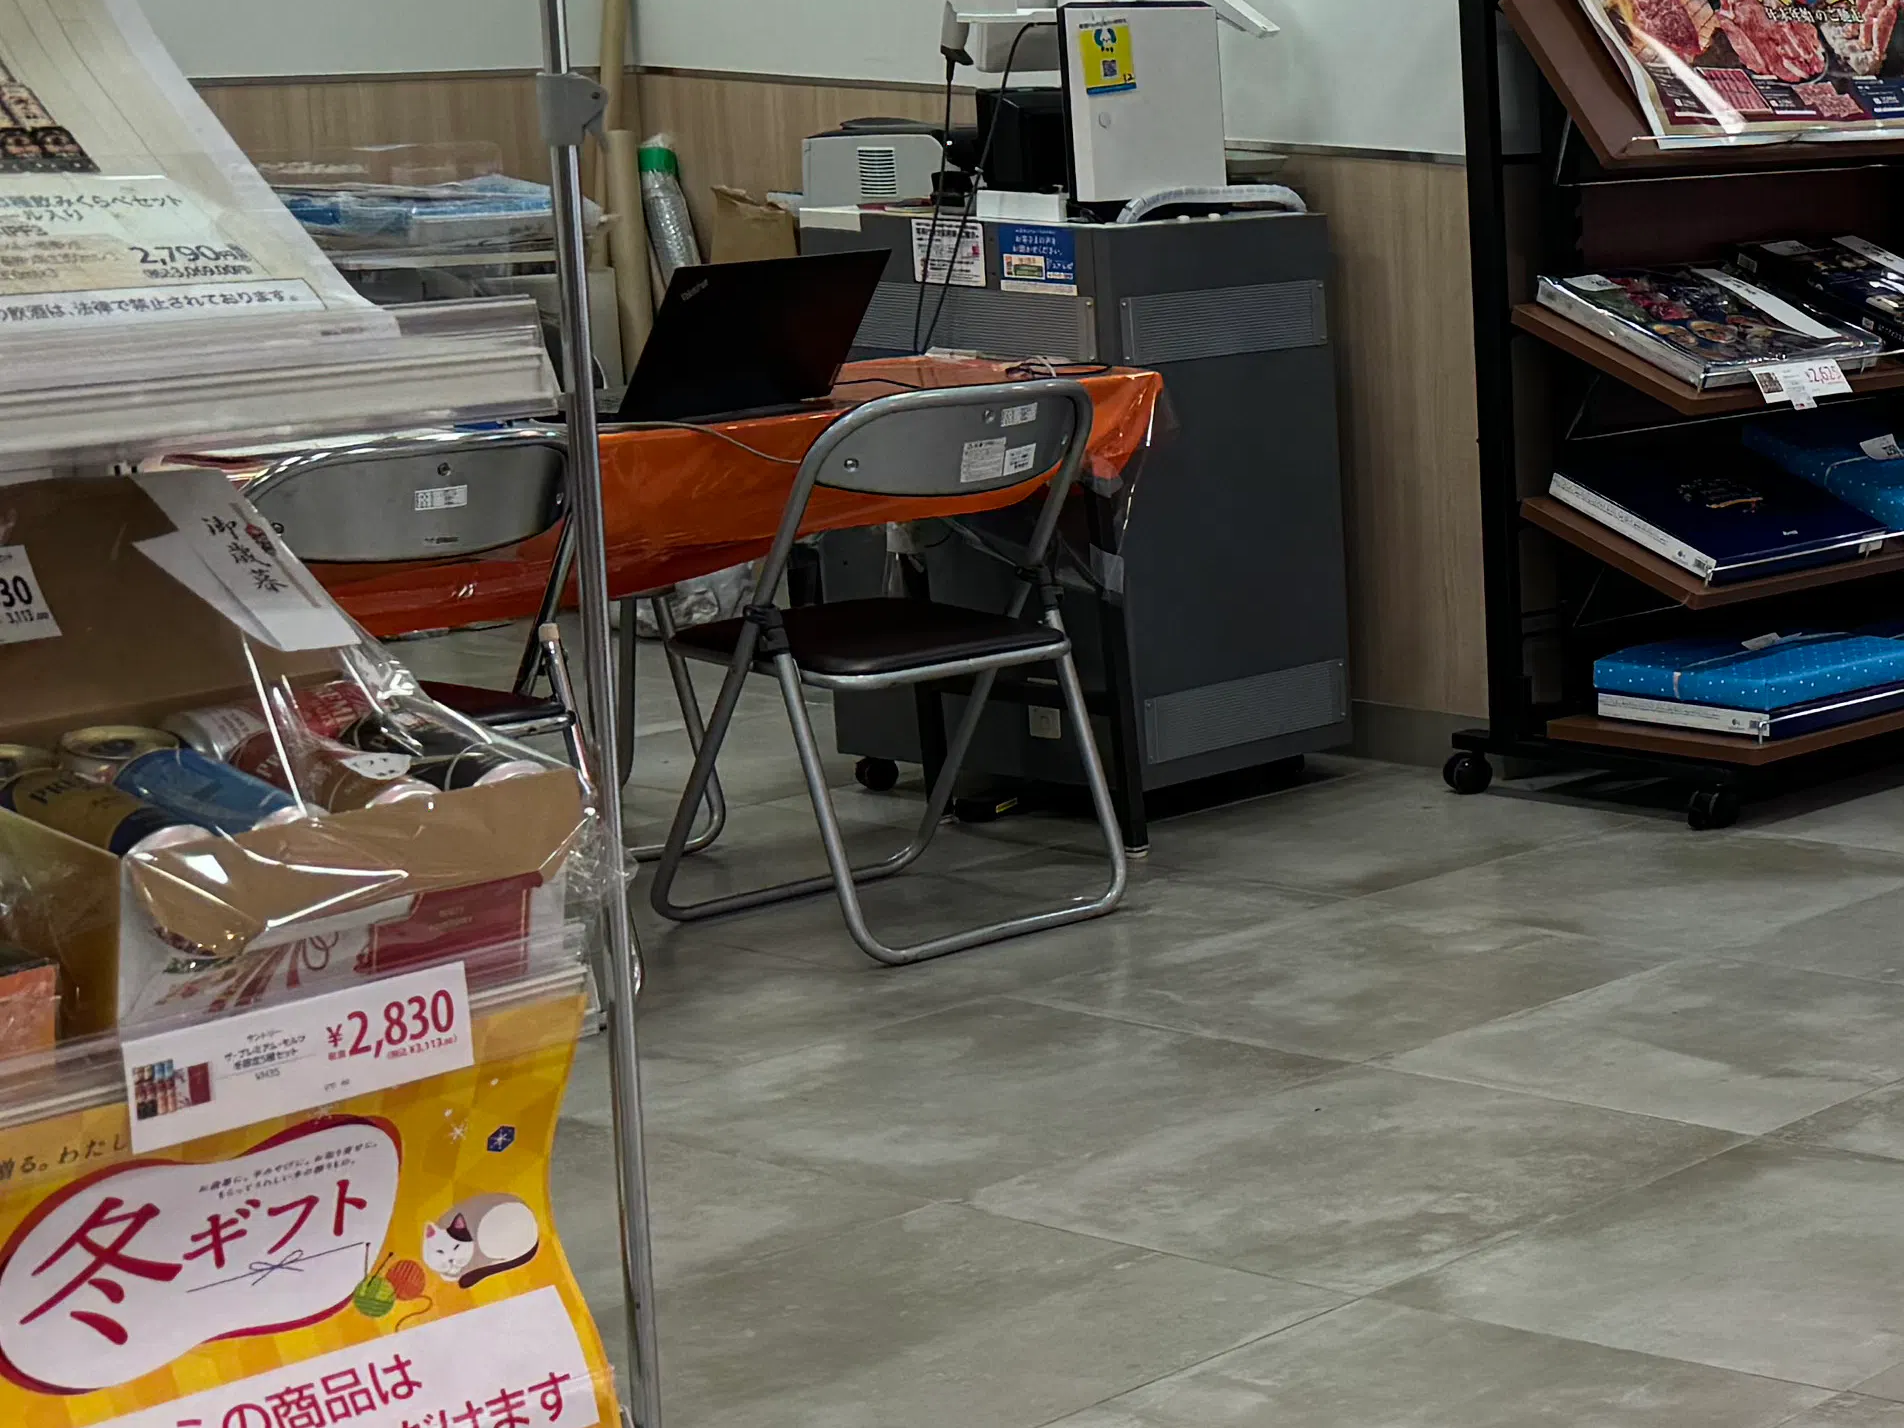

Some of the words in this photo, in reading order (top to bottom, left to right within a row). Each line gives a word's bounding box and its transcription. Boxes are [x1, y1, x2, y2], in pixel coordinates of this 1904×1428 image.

[325, 988, 456, 1059] ¥2,830
[18, 1176, 368, 1347] 冬ギフト
